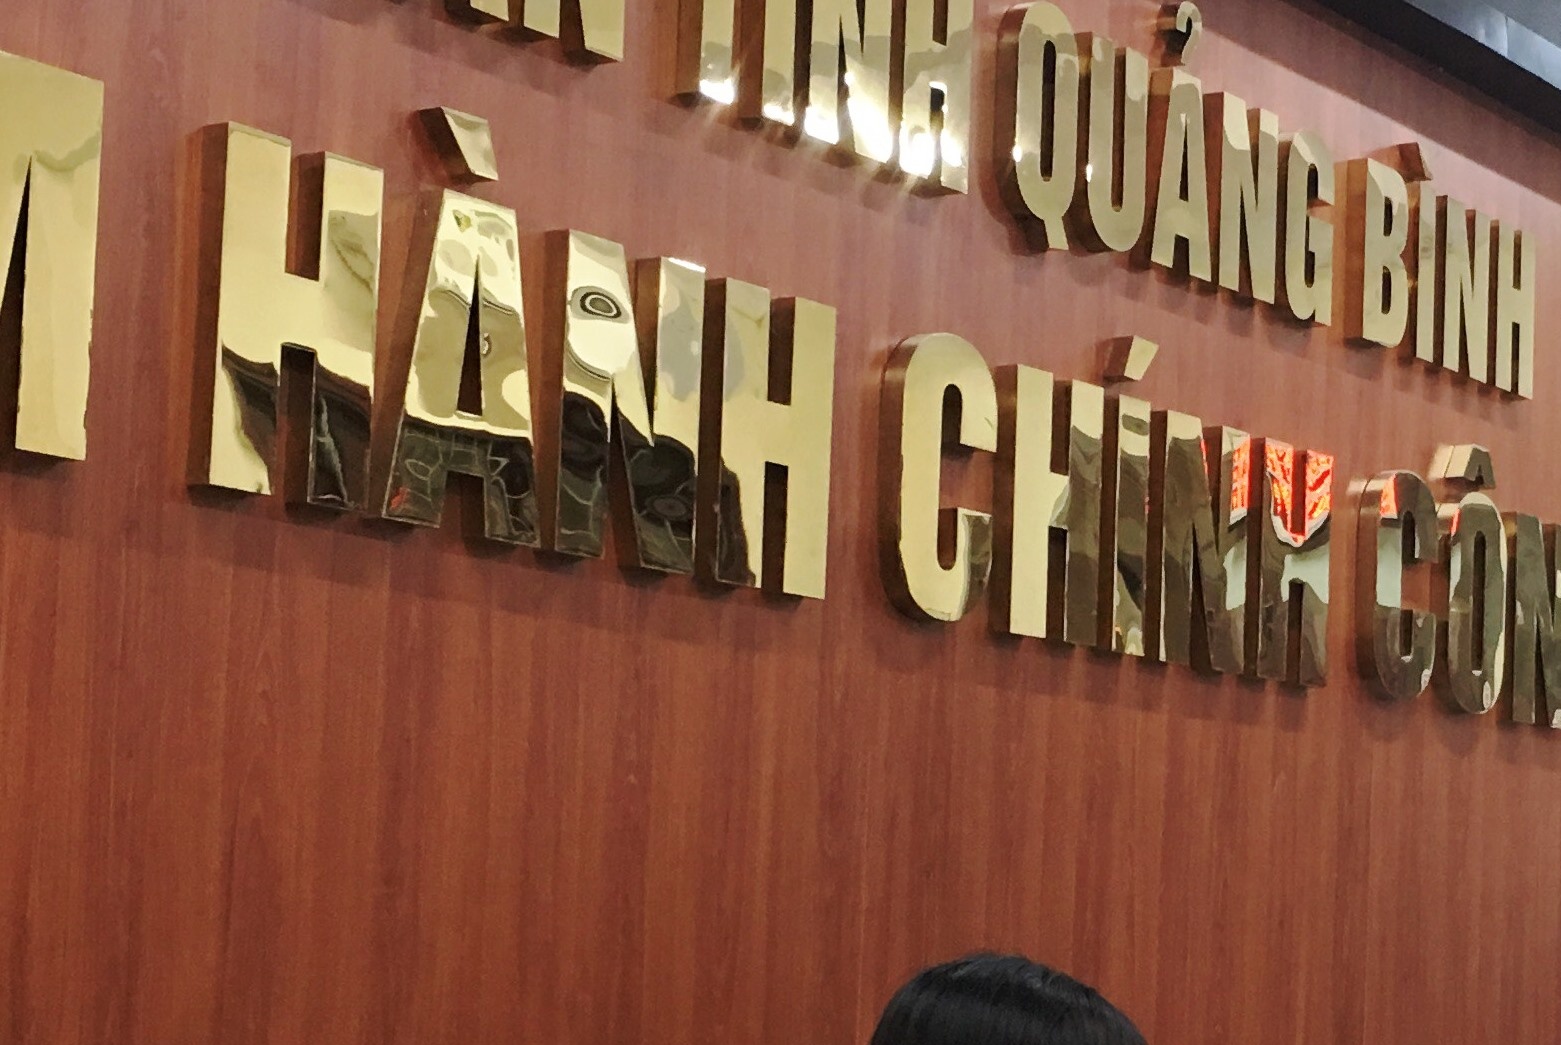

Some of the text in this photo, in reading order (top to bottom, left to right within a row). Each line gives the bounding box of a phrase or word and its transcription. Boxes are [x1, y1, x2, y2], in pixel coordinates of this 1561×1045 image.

[206, 104, 838, 600] HÀNH
[890, 331, 1335, 688] CHÍNH
[1010, 0, 1334, 327] QUẢNG
[1358, 142, 1536, 400] BÌNH
